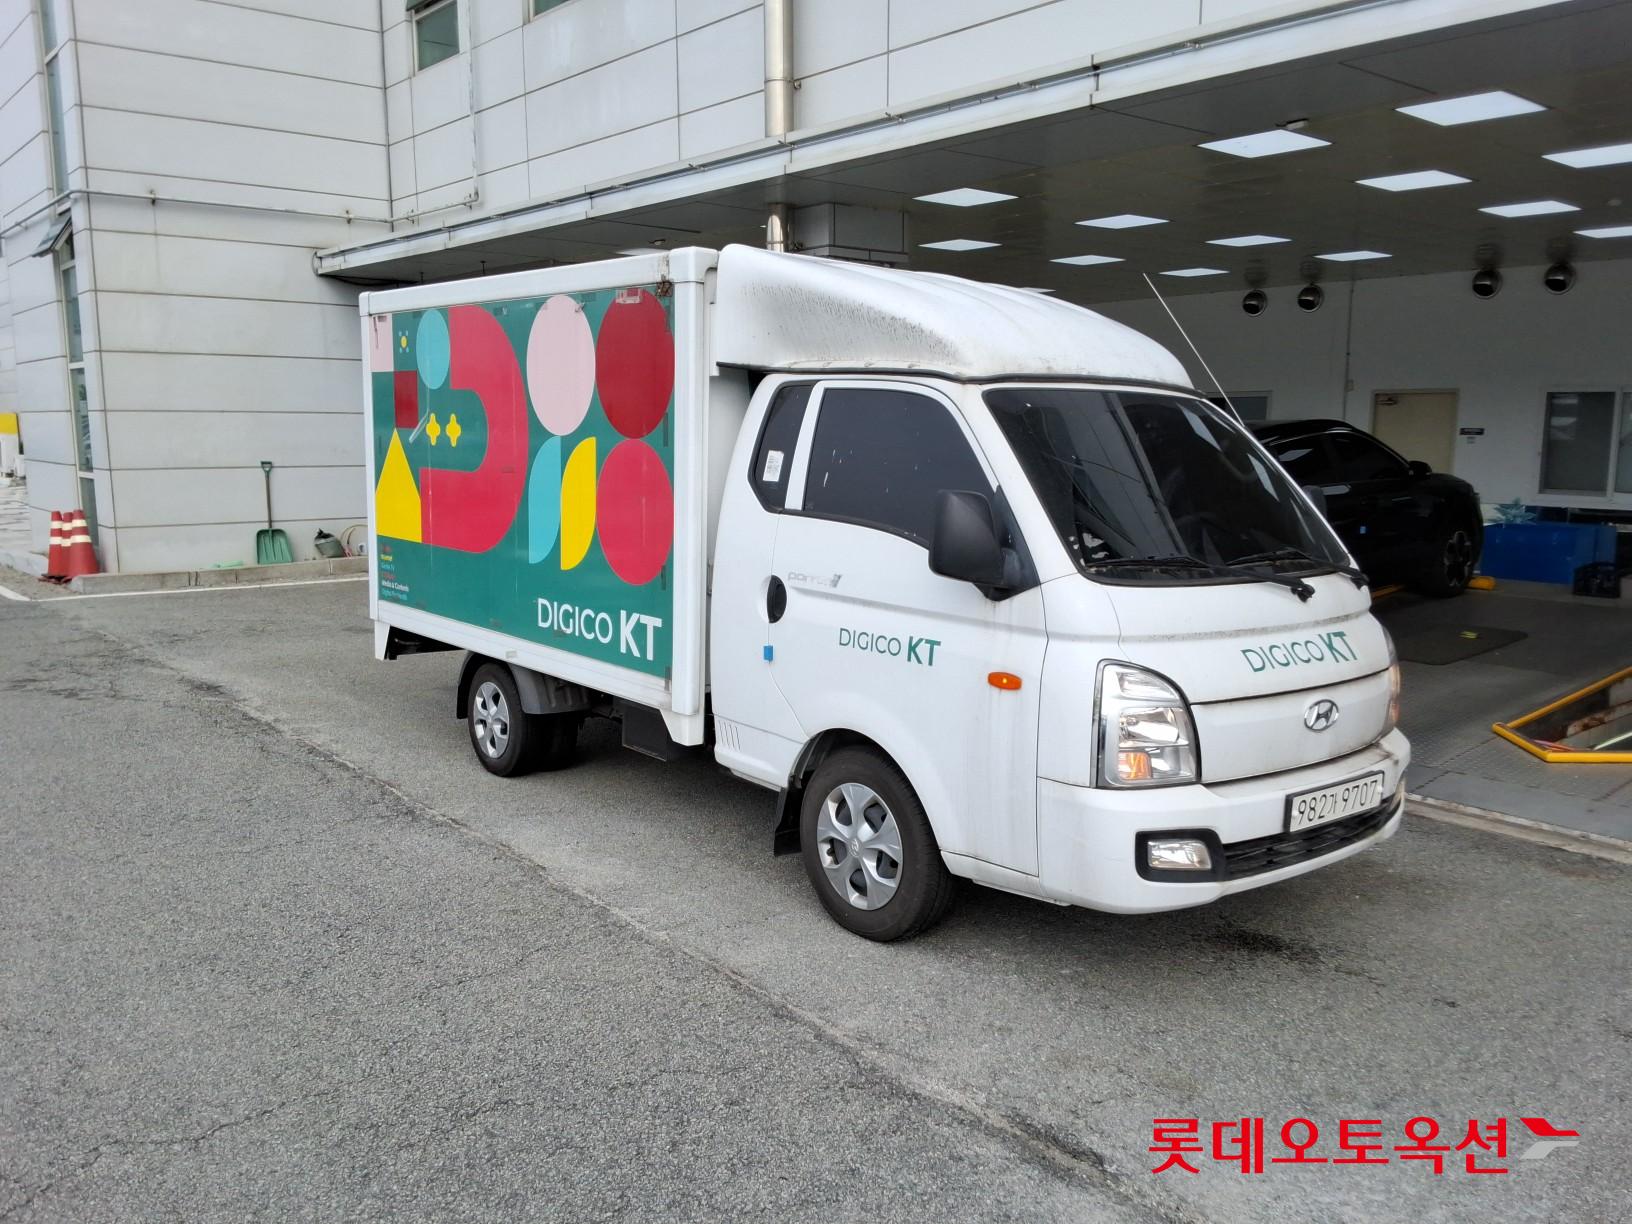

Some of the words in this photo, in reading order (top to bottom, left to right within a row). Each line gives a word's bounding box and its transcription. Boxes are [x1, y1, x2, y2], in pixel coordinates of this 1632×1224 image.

[538, 598, 613, 644] DIGICO
[620, 610, 662, 661] KT
[839, 627, 902, 657] DIGICO
[907, 636, 942, 666] KT
[1240, 640, 1325, 672] DIGICO
[1318, 631, 1358, 663] KT
[1342, 780, 1378, 813] 9707
